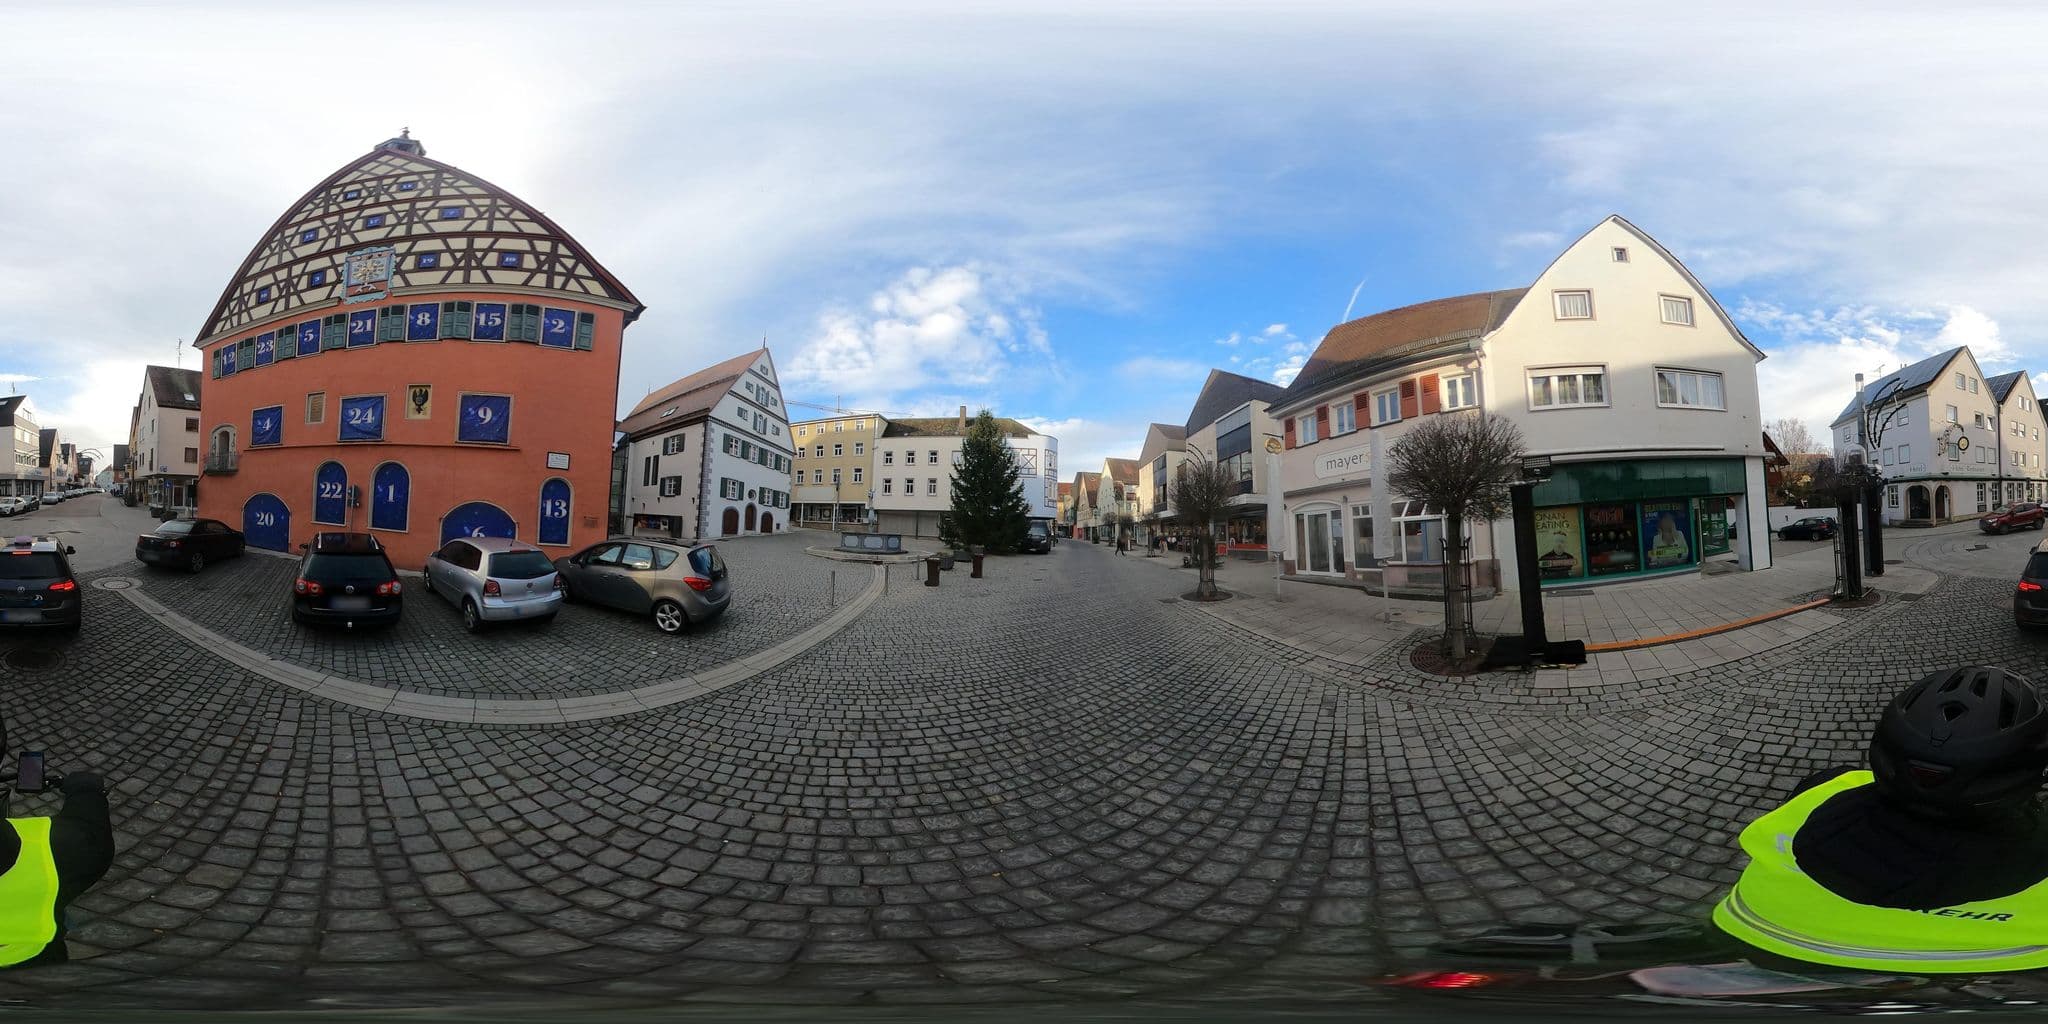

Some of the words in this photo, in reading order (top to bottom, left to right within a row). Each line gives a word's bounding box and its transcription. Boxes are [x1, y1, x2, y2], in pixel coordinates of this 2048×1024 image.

[351, 318, 373, 334] 21
[416, 311, 431, 327] 8
[477, 312, 502, 327] 15
[551, 318, 566, 334] 2
[303, 329, 314, 343] 5
[257, 339, 274, 355] 23
[222, 351, 236, 366] 12
[348, 407, 375, 425] 24
[477, 406, 493, 425] 9
[262, 417, 272, 431] 4
[1326, 453, 1364, 470] mayer
[320, 481, 343, 499] 22
[387, 484, 396, 502] 1
[543, 499, 568, 519] 13
[1535, 511, 1567, 521] ONAN
[255, 511, 275, 527] 20
[1535, 520, 1570, 530] EATING
[471, 526, 486, 538] 6
